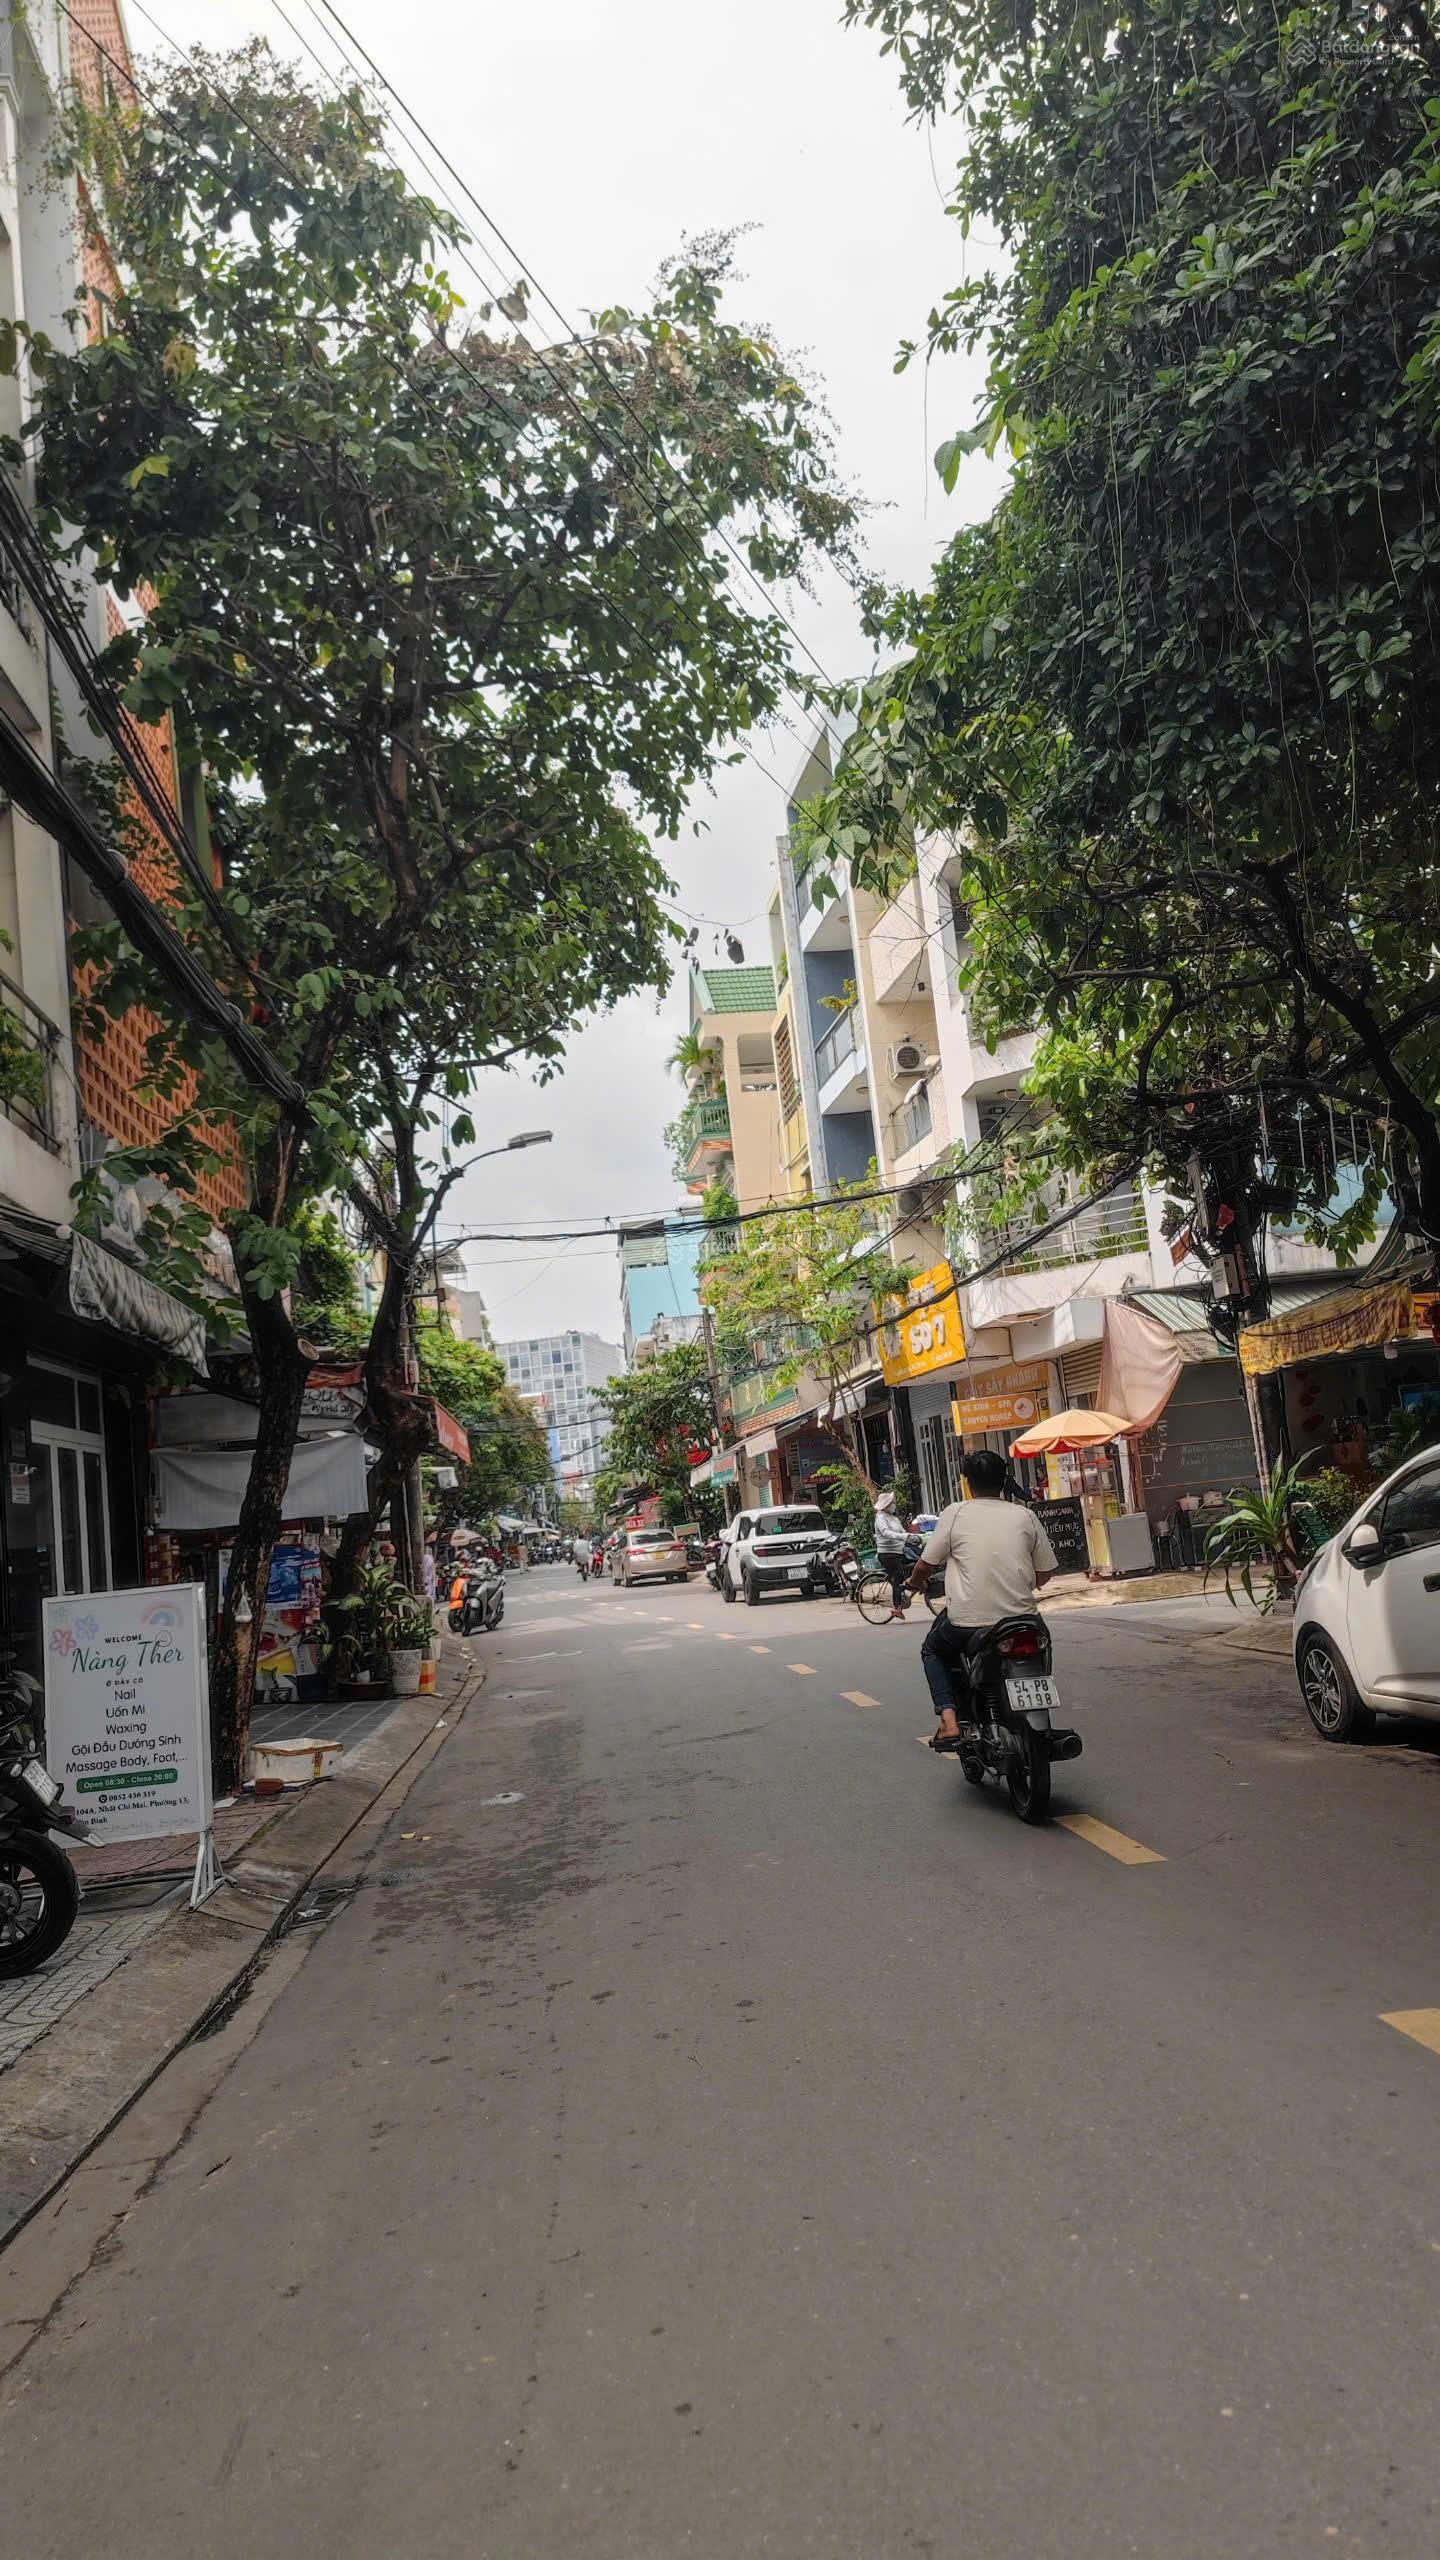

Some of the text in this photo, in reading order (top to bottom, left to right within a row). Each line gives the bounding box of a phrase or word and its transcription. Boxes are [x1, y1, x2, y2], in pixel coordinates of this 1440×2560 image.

[1006, 1367, 1038, 1390] NHANH
[1058, 1538, 1076, 1549] KHO
[104, 1634, 143, 1644] WELCOME
[71, 1640, 185, 1675] Nàng Ther
[114, 1687, 136, 1701] Nail
[1017, 1693, 1053, 1708] 6198
[105, 1704, 145, 1719] Uốn Mi
[105, 1722, 147, 1736] Waxing
[71, 1744, 90, 1757] Gội
[158, 1734, 182, 1746] Sinh
[65, 1759, 118, 1775] Massage
[83, 1780, 104, 1790] Open
[104, 1777, 125, 1787] 08:30
[131, 1775, 152, 1784] Close
